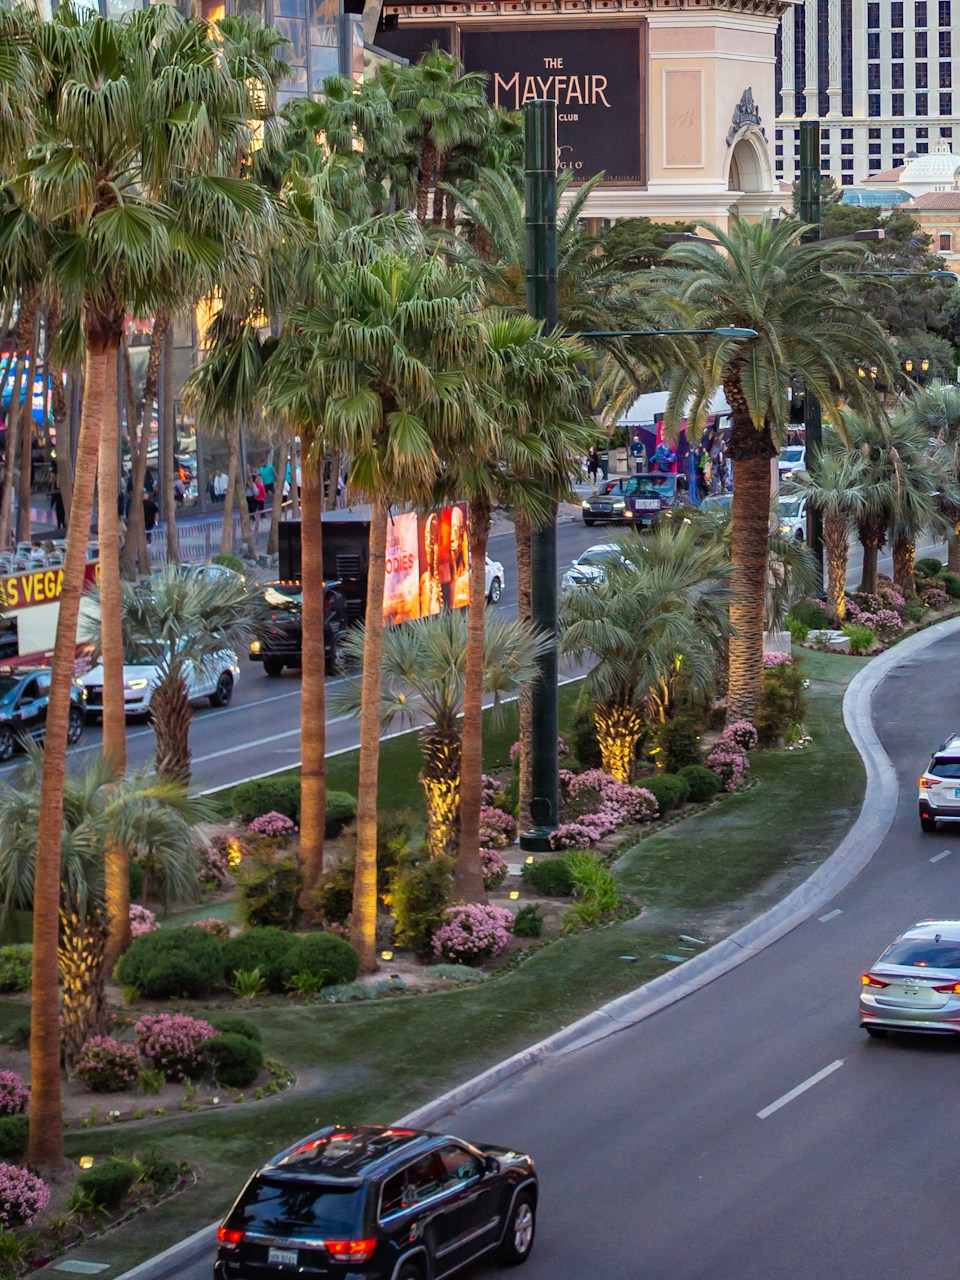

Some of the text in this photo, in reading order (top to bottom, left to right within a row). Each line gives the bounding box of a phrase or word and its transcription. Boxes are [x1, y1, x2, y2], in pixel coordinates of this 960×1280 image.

[544, 58, 563, 68] THE
[494, 72, 611, 110] MAYFAIR
[384, 553, 414, 574] ODIES
[22, 569, 64, 602] VEGA
